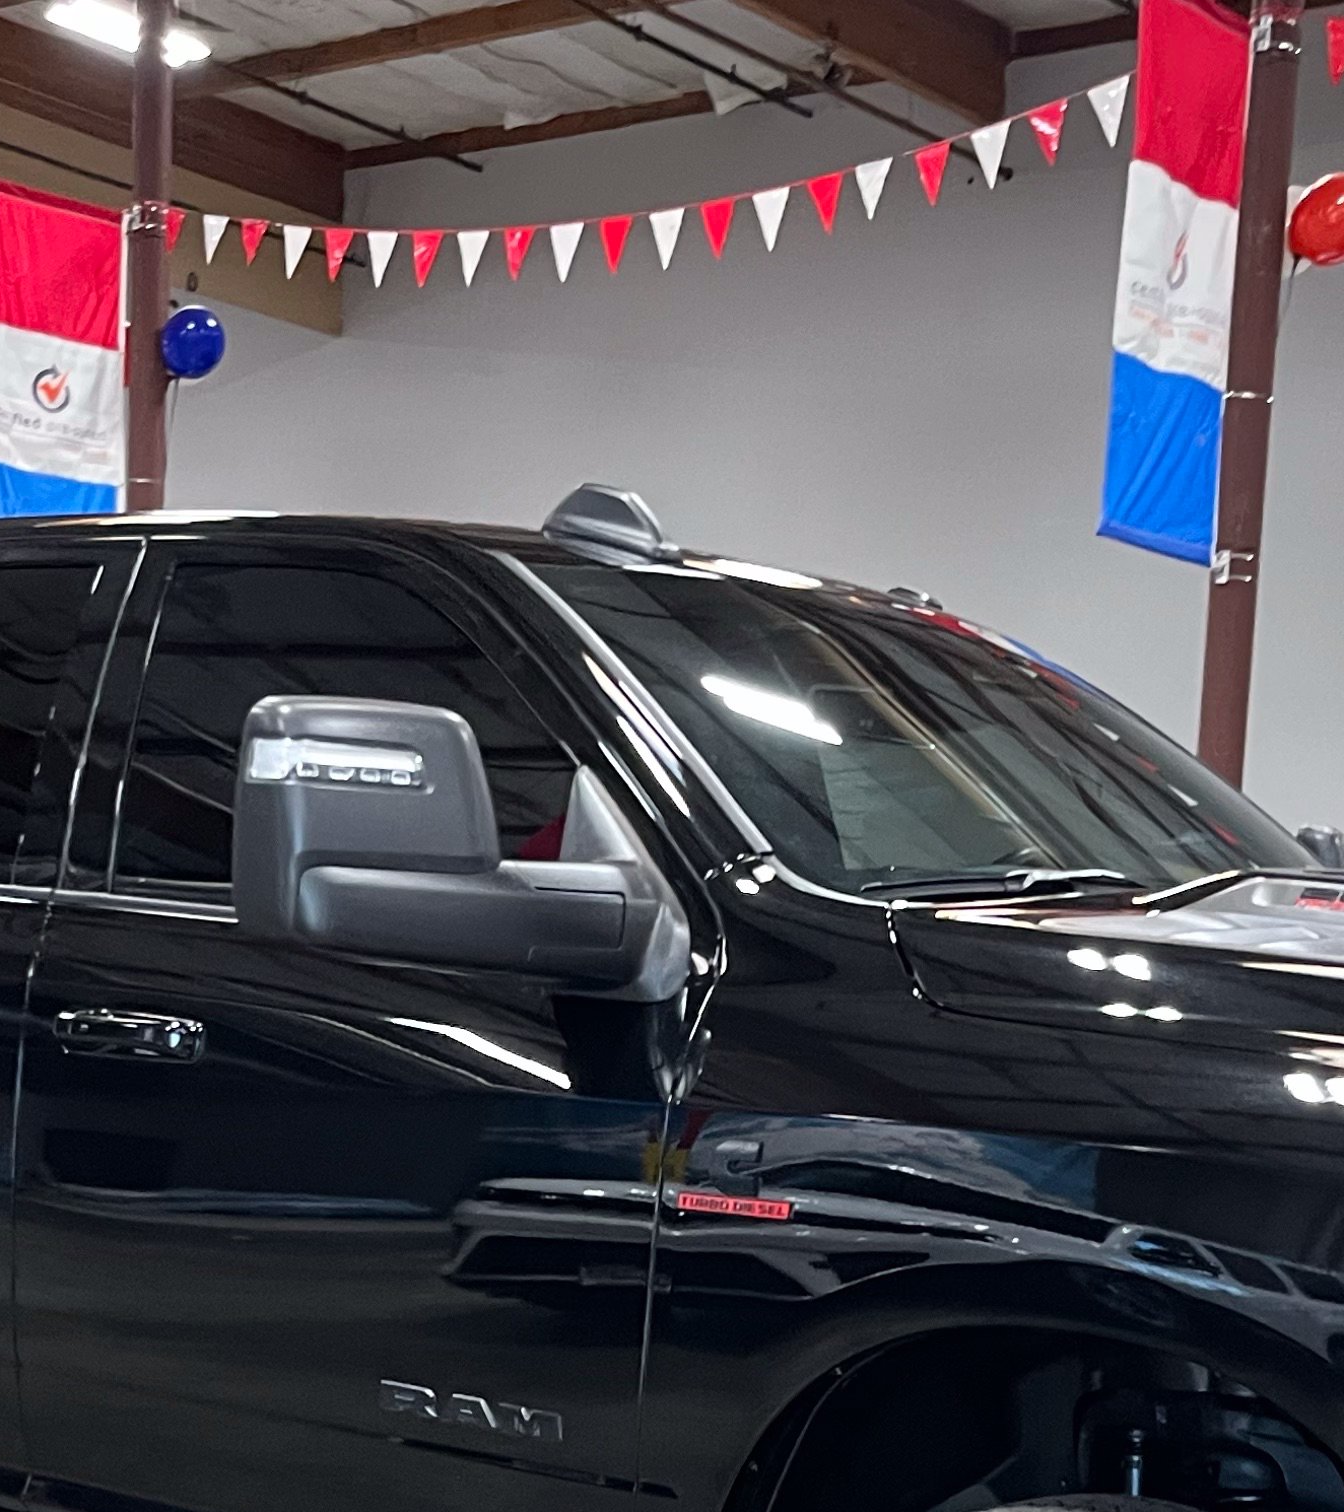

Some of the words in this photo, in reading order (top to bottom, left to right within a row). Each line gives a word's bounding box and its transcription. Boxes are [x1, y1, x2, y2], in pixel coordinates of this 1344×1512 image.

[681, 1195, 729, 1211] TURBO
[732, 1201, 786, 1217] DIESEL
[378, 1379, 563, 1441] RAM
